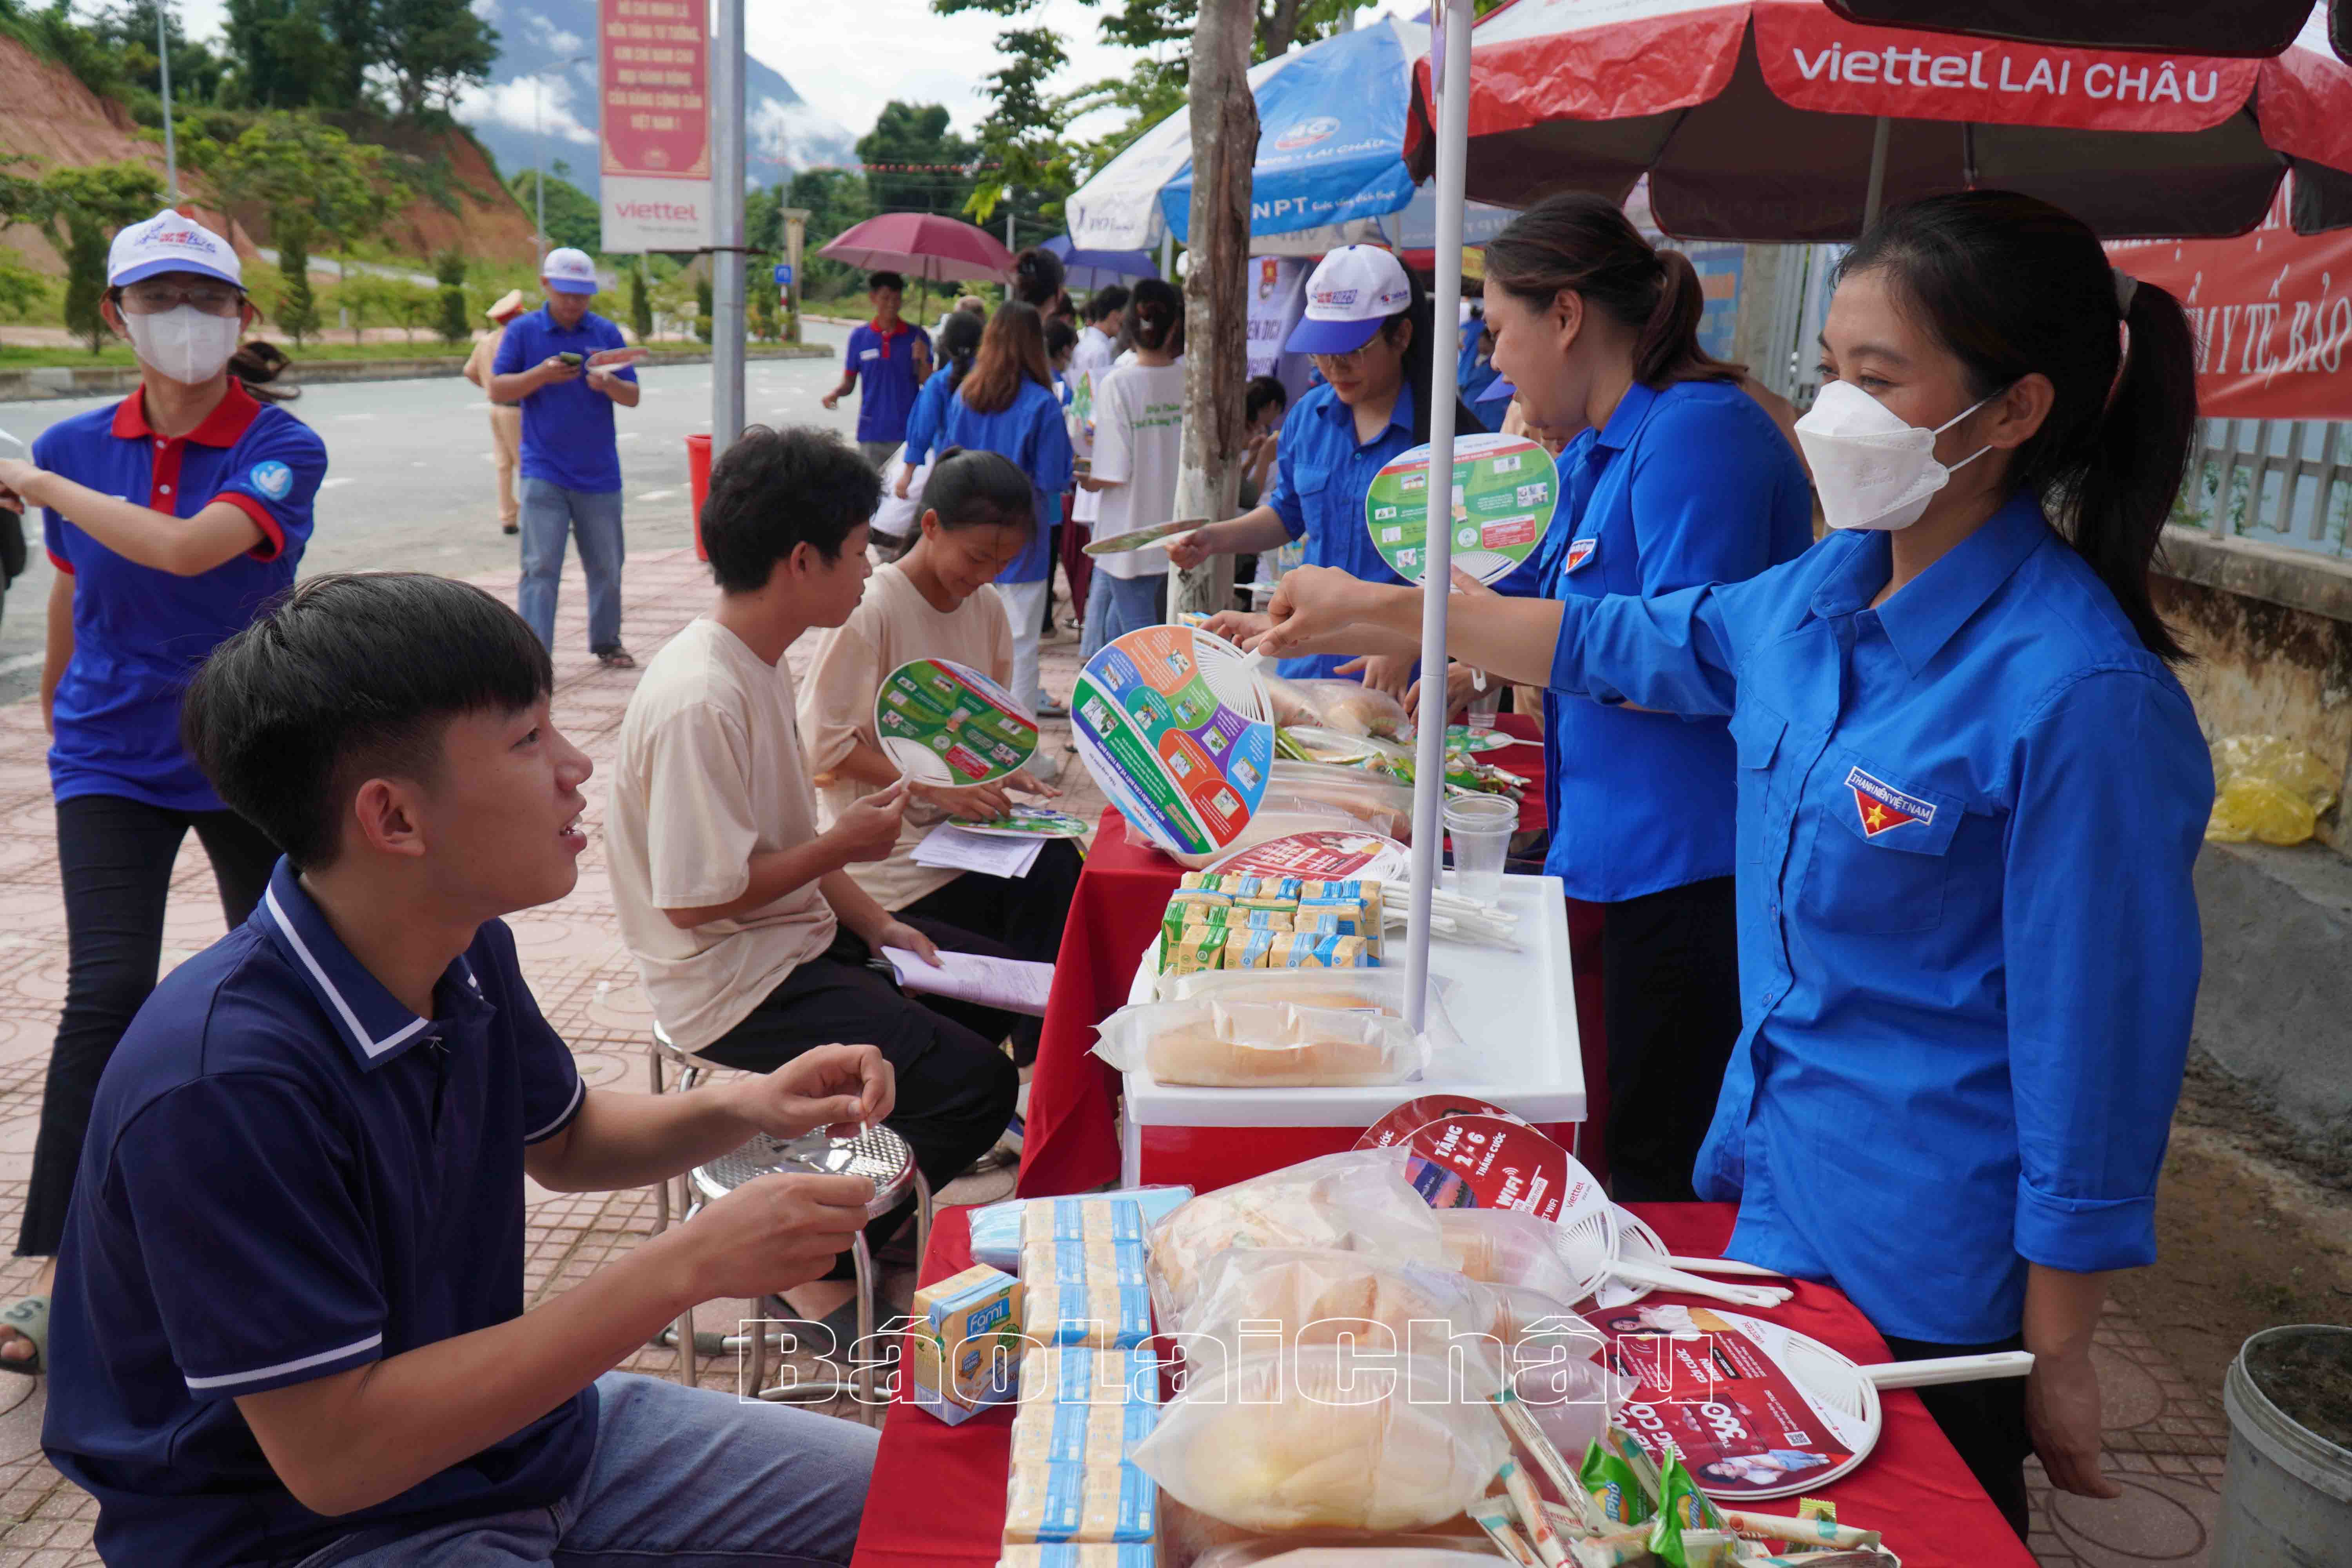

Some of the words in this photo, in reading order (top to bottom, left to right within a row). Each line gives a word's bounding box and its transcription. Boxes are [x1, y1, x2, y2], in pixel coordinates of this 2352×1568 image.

[1793, 40, 1987, 89] viettel
[2000, 56, 2069, 96] LAI
[2083, 61, 2218, 103] CHÂU
[615, 199, 698, 221] viettel
[1252, 196, 1308, 220] NPT
[1850, 773, 1876, 793] THANH
[1907, 801, 1931, 819] NAM
[1377, 1130, 1395, 1149] ƯỚC
[1435, 1125, 1463, 1157] TẶNG
[1454, 1155, 1473, 1166] 2
[1468, 1132, 1485, 1143] 6
[1476, 1152, 1495, 1176] THÁNG
[1490, 1132, 1506, 1152] CƯỚC
[1496, 1176, 1520, 1207] WIFI
[1545, 1198, 1558, 1213] WIFI
[1566, 1181, 1584, 1208] viettel
[970, 1302, 1003, 1332] Fami
[1744, 1321, 1764, 1345] viettel
[1624, 1404, 1664, 1431] CÓ
[1701, 1402, 1747, 1441] 360
